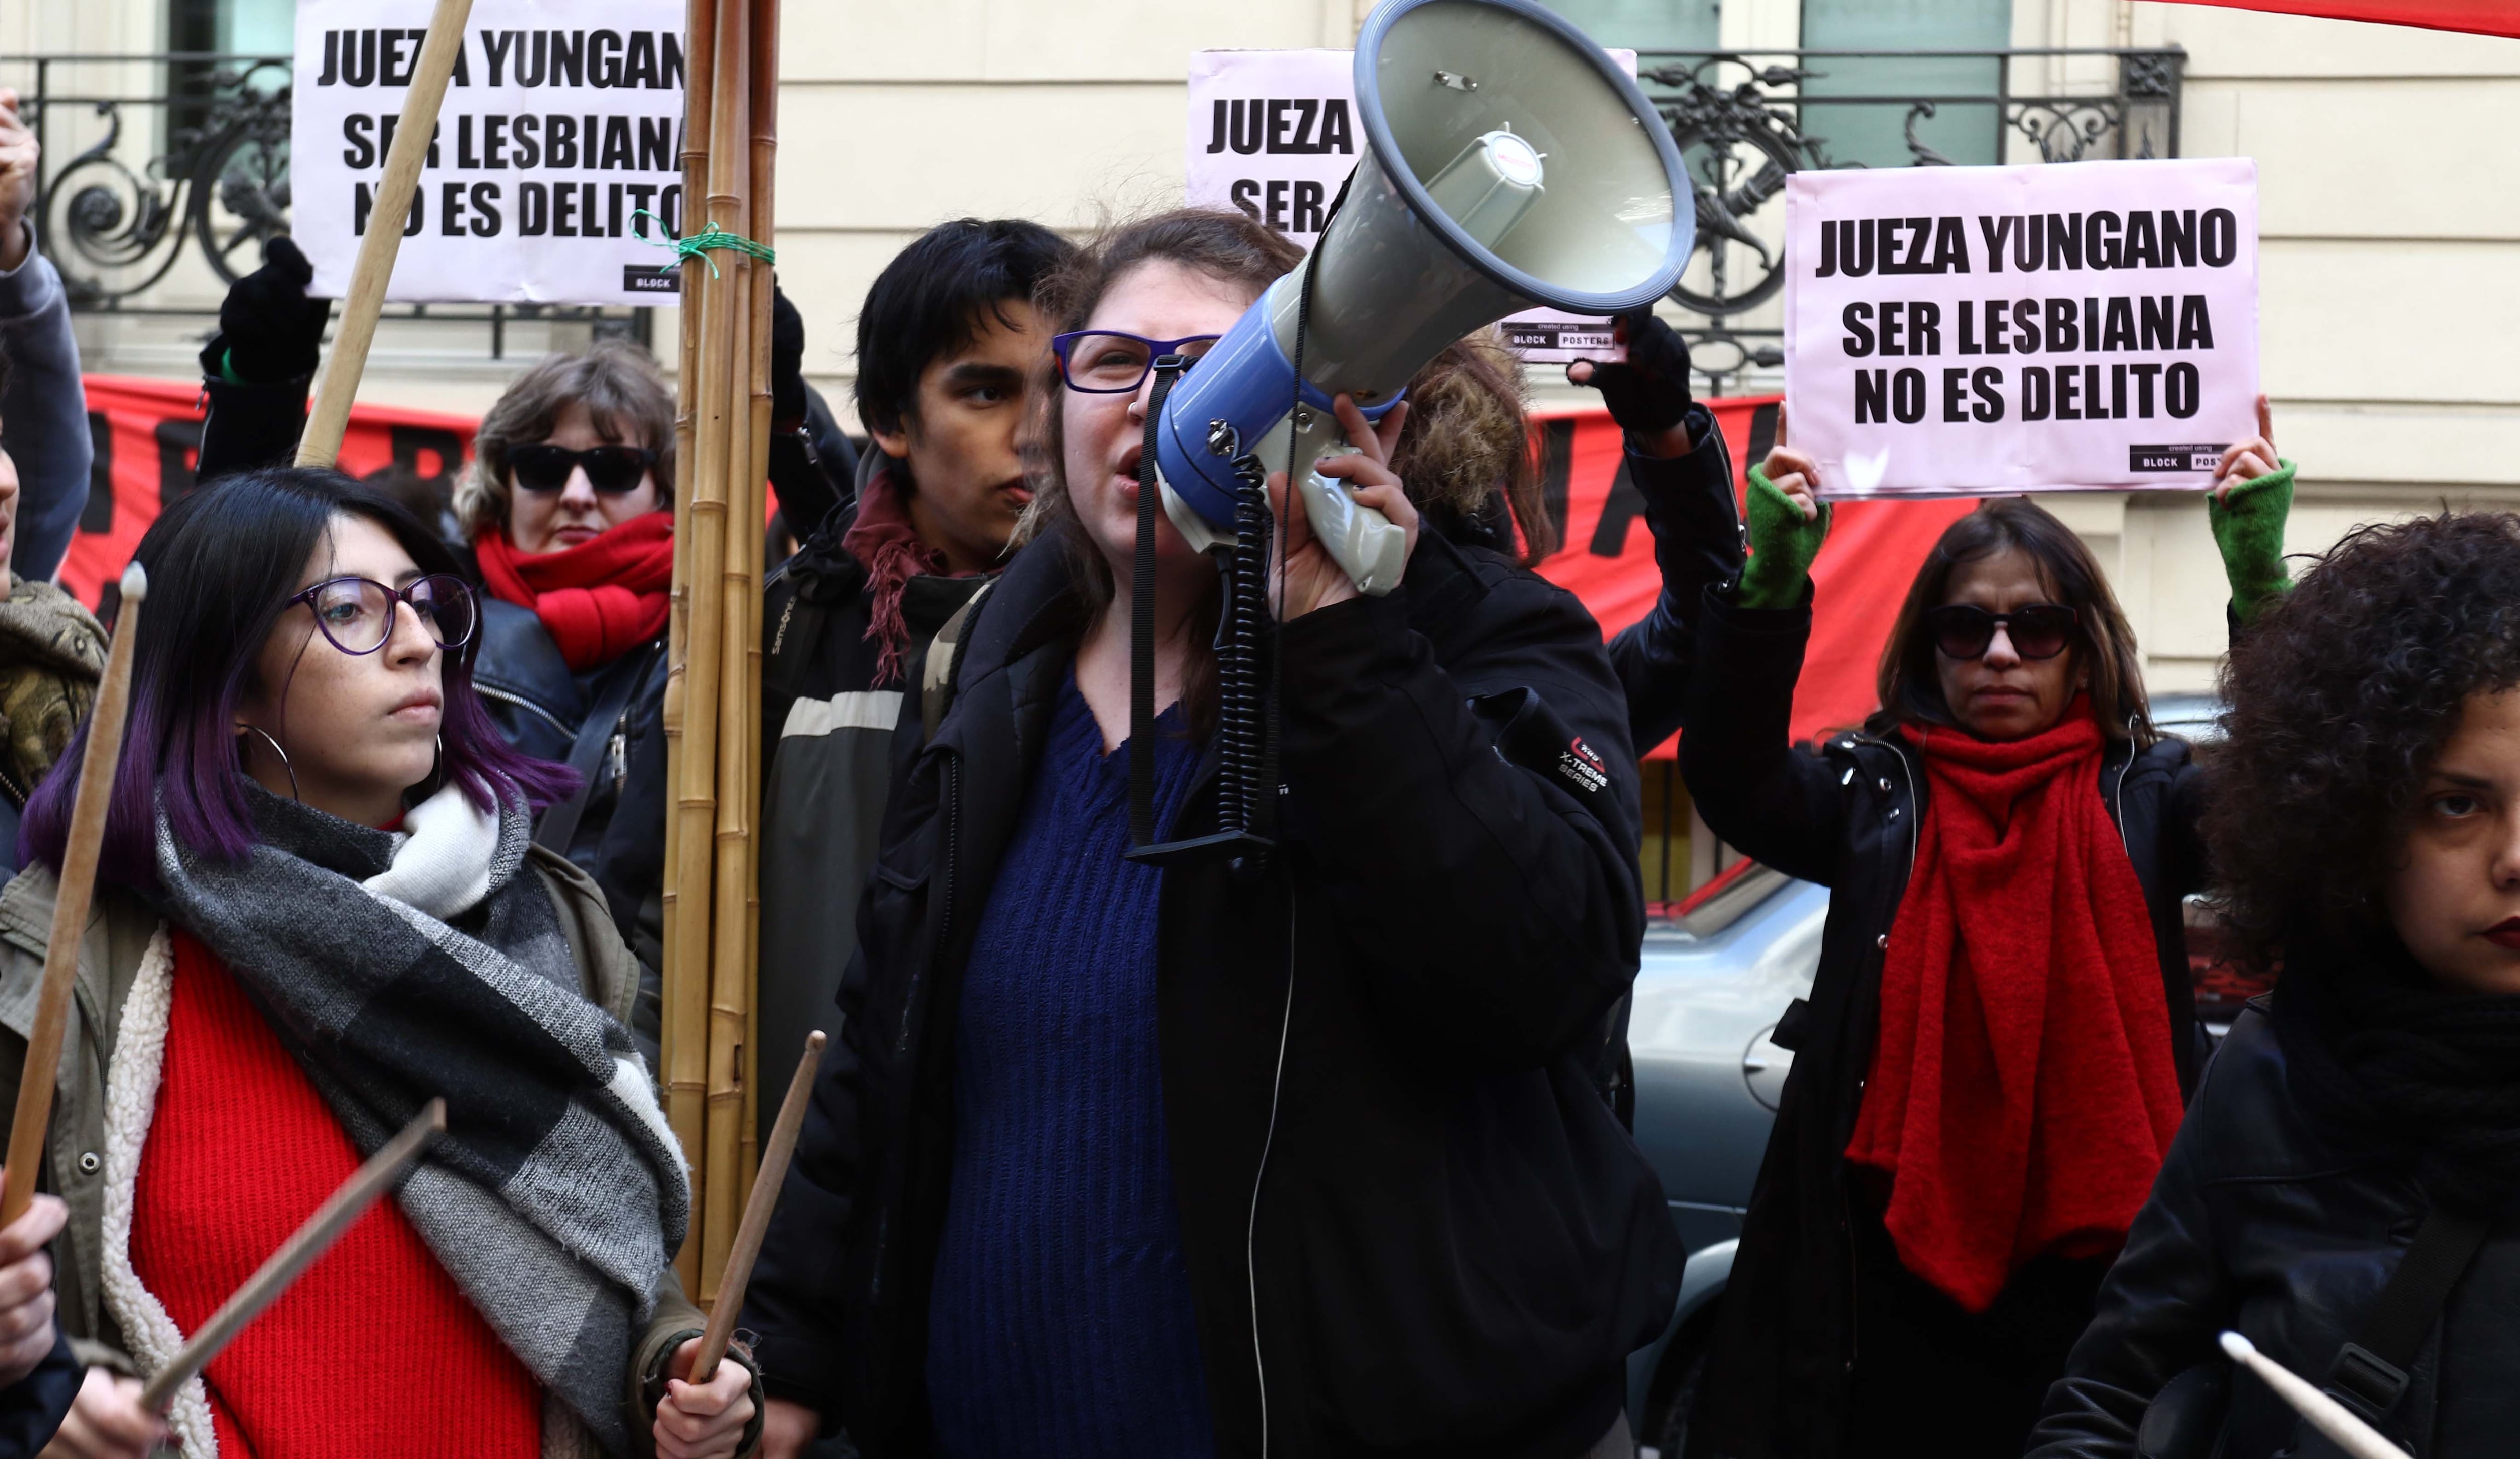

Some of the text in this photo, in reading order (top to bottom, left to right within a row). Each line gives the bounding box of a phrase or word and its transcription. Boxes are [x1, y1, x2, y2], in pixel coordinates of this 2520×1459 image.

[458, 115, 682, 172] LESBIAN
[1207, 99, 1353, 155] JUEZA
[442, 182, 501, 237] ES
[519, 183, 682, 240] DELITO
[1231, 178, 1325, 232] SER
[1816, 208, 2236, 278] JUEZA YUNGANO
[636, 278, 671, 288] BLOCK
[1513, 335, 1609, 345] BLOCK POSTERS
[1843, 295, 2214, 357] SER LESBIANA
[1855, 362, 2200, 424] NO ES DELITO
[2143, 458, 2178, 467] BLOCK
[1559, 751, 1608, 787] X-TREME
[1559, 764, 1599, 792] SERIES
